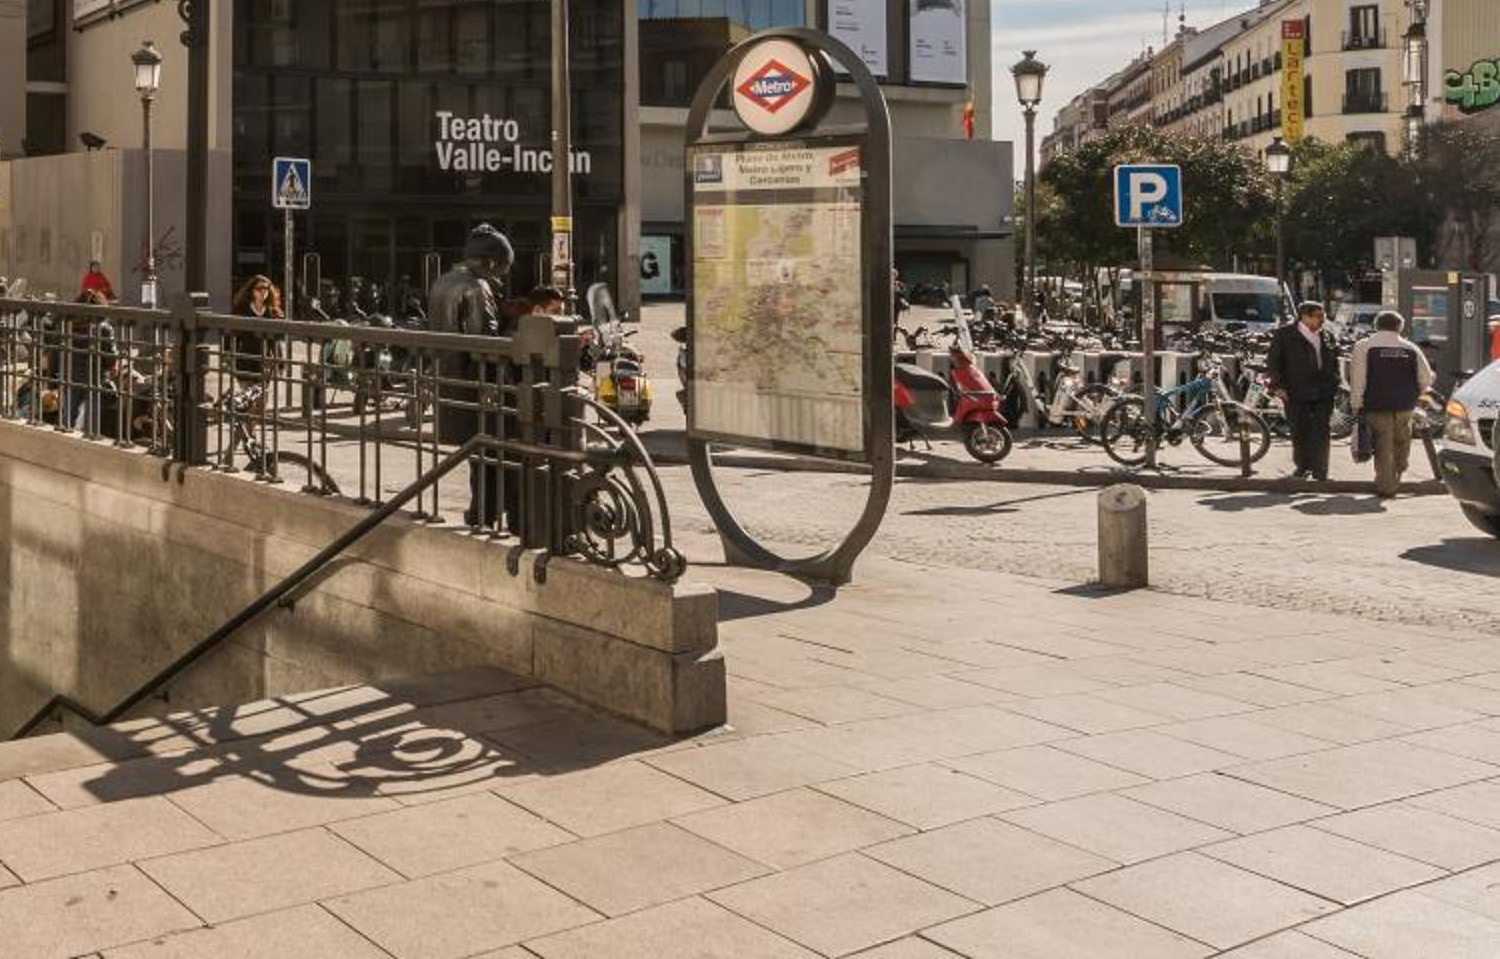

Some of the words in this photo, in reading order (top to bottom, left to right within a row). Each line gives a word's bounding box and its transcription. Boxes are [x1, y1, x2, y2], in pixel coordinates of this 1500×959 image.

[753, 78, 791, 96] Metro
[435, 110, 519, 142] Teatro
[435, 142, 591, 174] Valle-Incn
[1129, 172, 1167, 219] P
